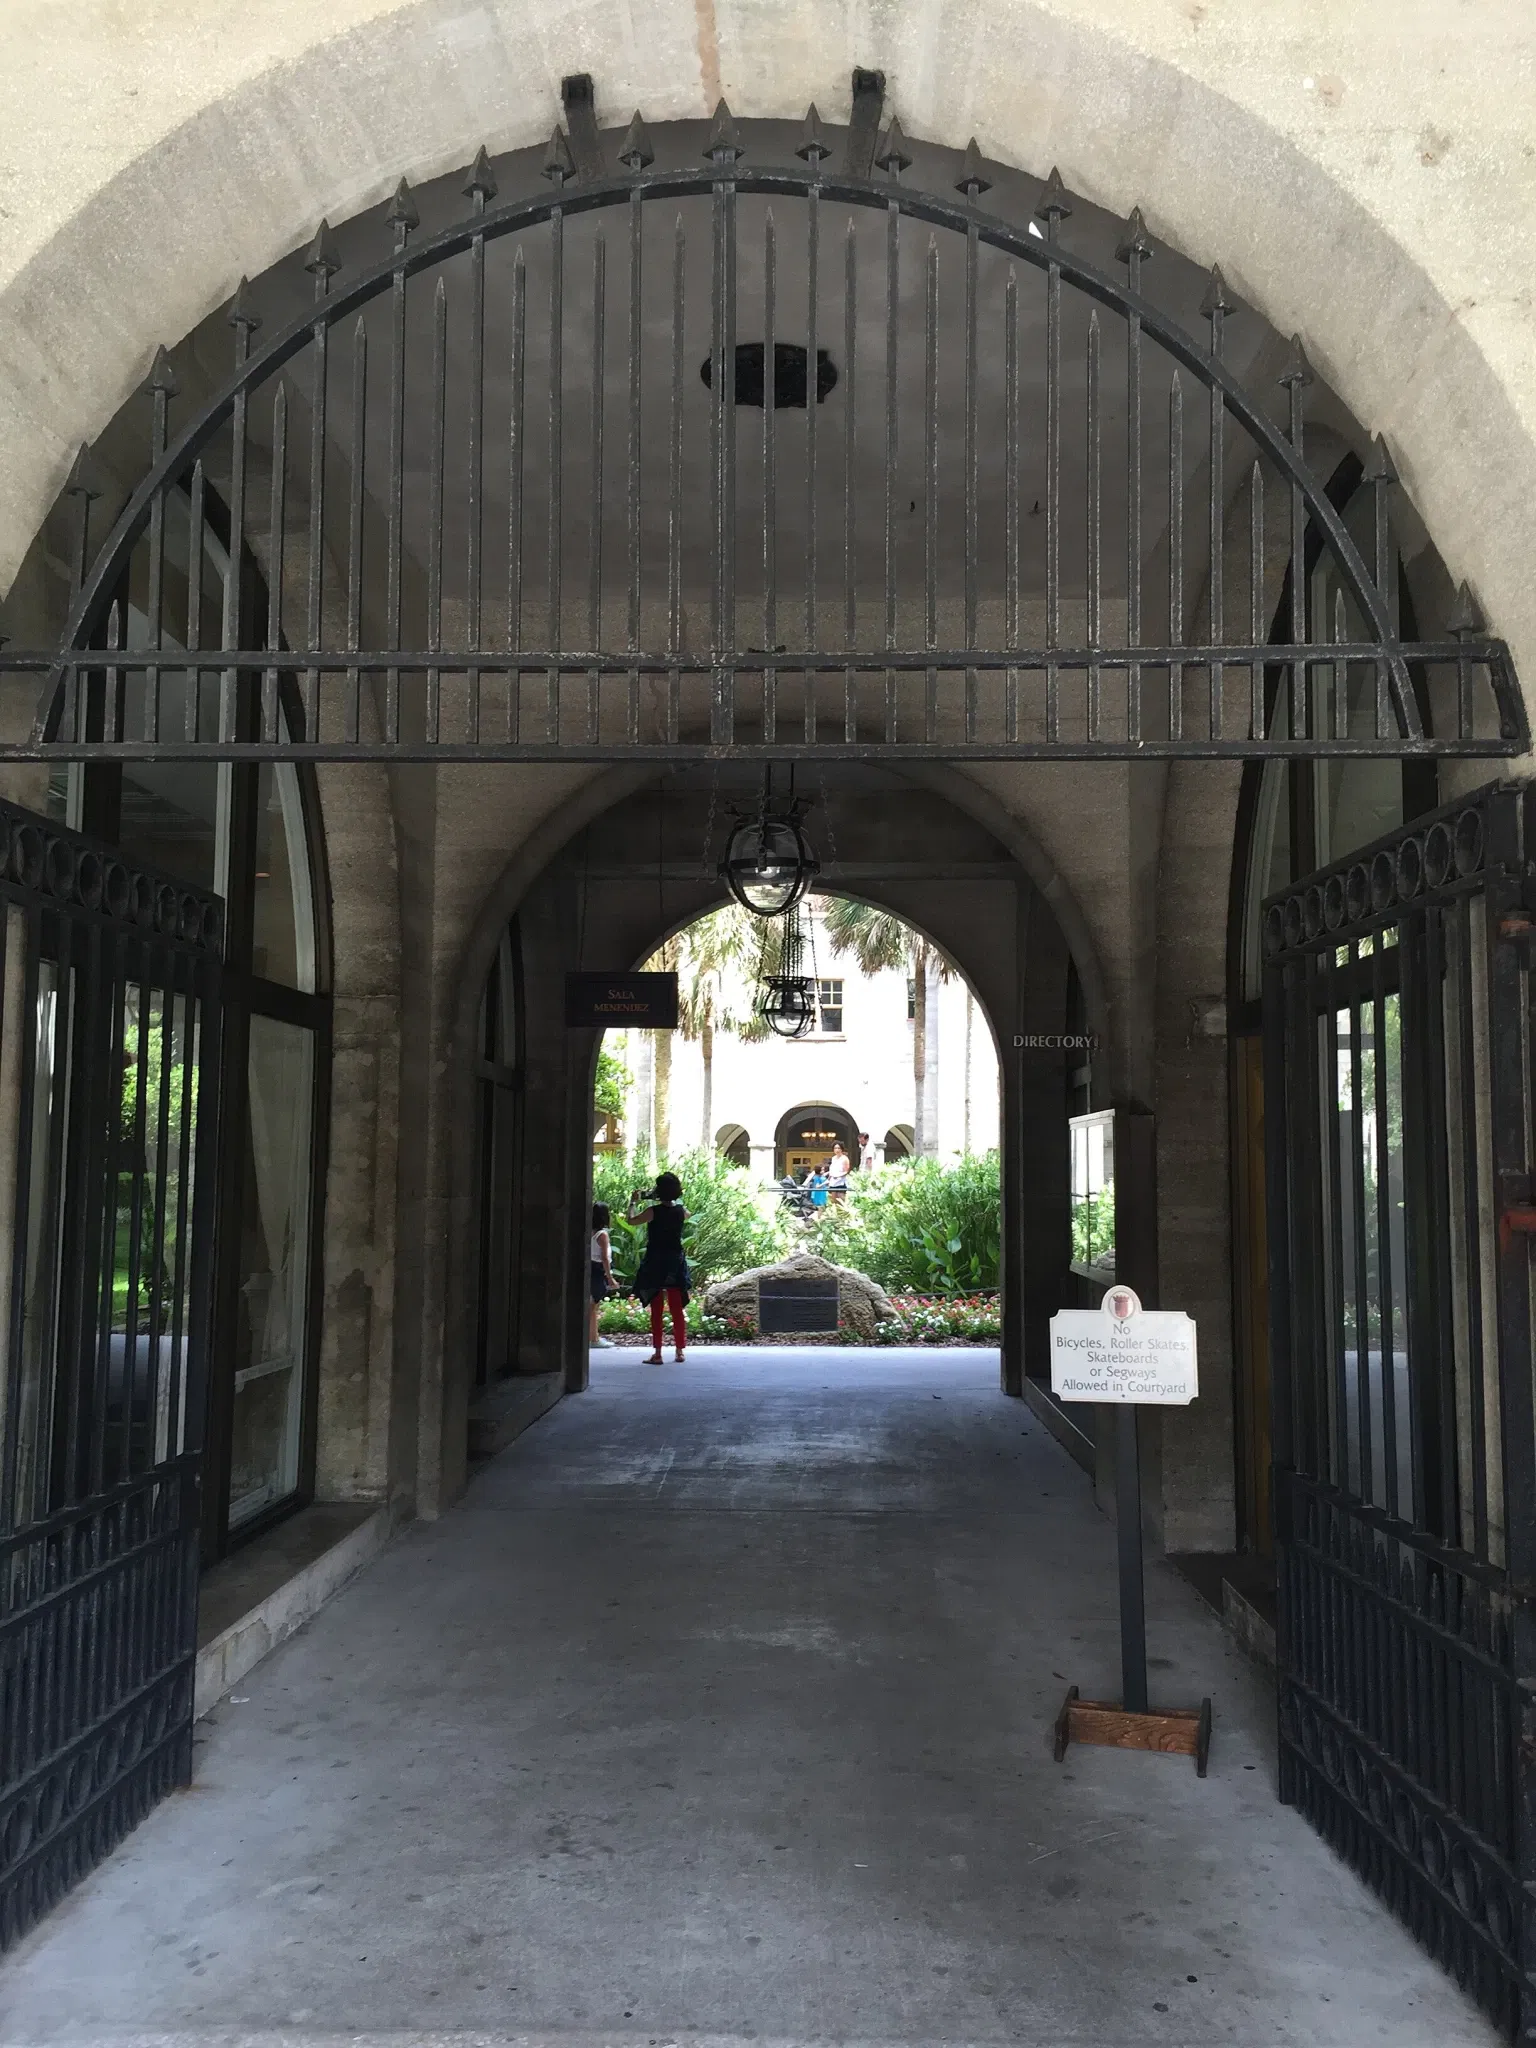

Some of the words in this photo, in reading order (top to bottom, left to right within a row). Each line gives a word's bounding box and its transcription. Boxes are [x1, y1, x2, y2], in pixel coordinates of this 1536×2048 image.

[594, 1003, 649, 1012] MENENDEZ
[1013, 1035, 1093, 1048] DIRECTORY
[1113, 1324, 1131, 1335] No
[1056, 1336, 1106, 1350] Bicycles,
[1110, 1338, 1142, 1349] Roller
[1147, 1338, 1190, 1351] Skates,
[1087, 1351, 1159, 1364] Skateboards
[1089, 1366, 1102, 1377] or
[1106, 1366, 1157, 1380] Segways
[1062, 1379, 1108, 1391] Allowed
[1112, 1381, 1123, 1391] in
[1127, 1381, 1187, 1396] Courtyard
